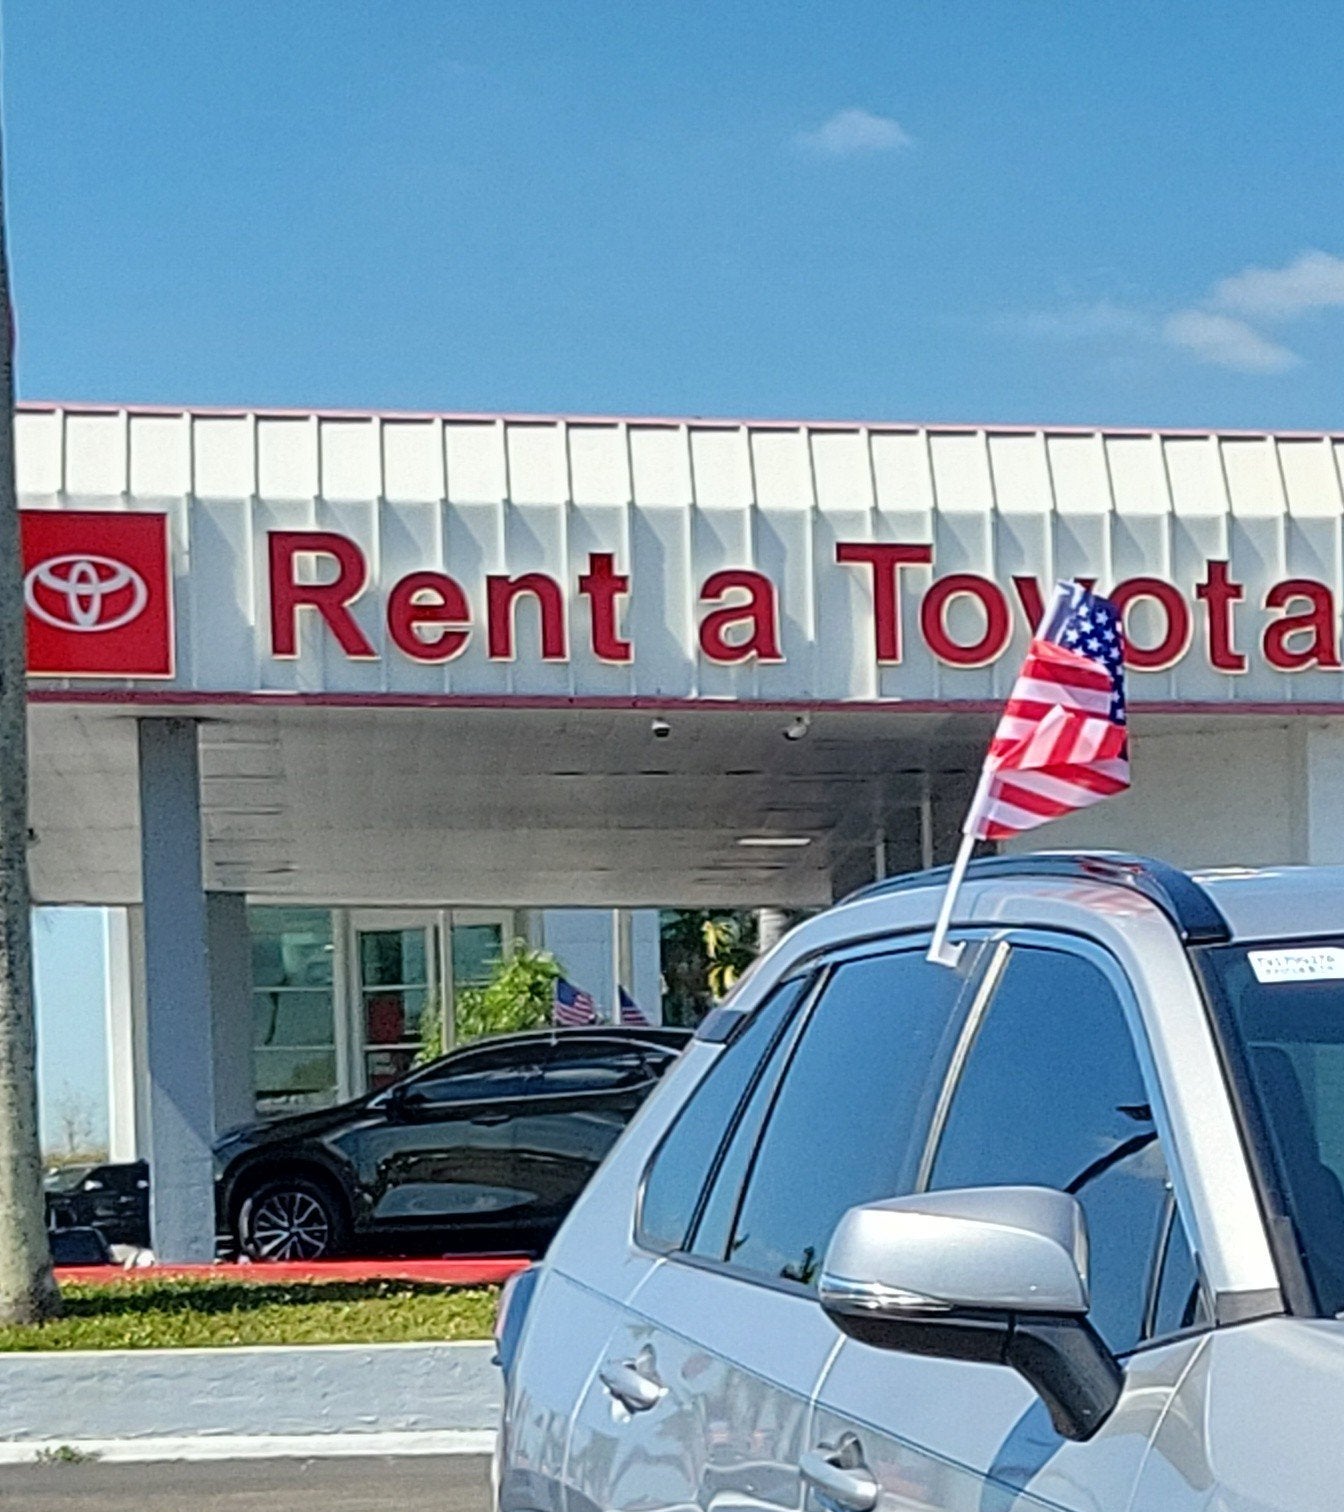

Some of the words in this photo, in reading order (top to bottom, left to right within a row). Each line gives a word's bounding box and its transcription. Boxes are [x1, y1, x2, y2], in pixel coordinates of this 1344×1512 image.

[266, 529, 634, 664] Rent
[698, 569, 787, 664] a
[835, 541, 1344, 674] Toota
